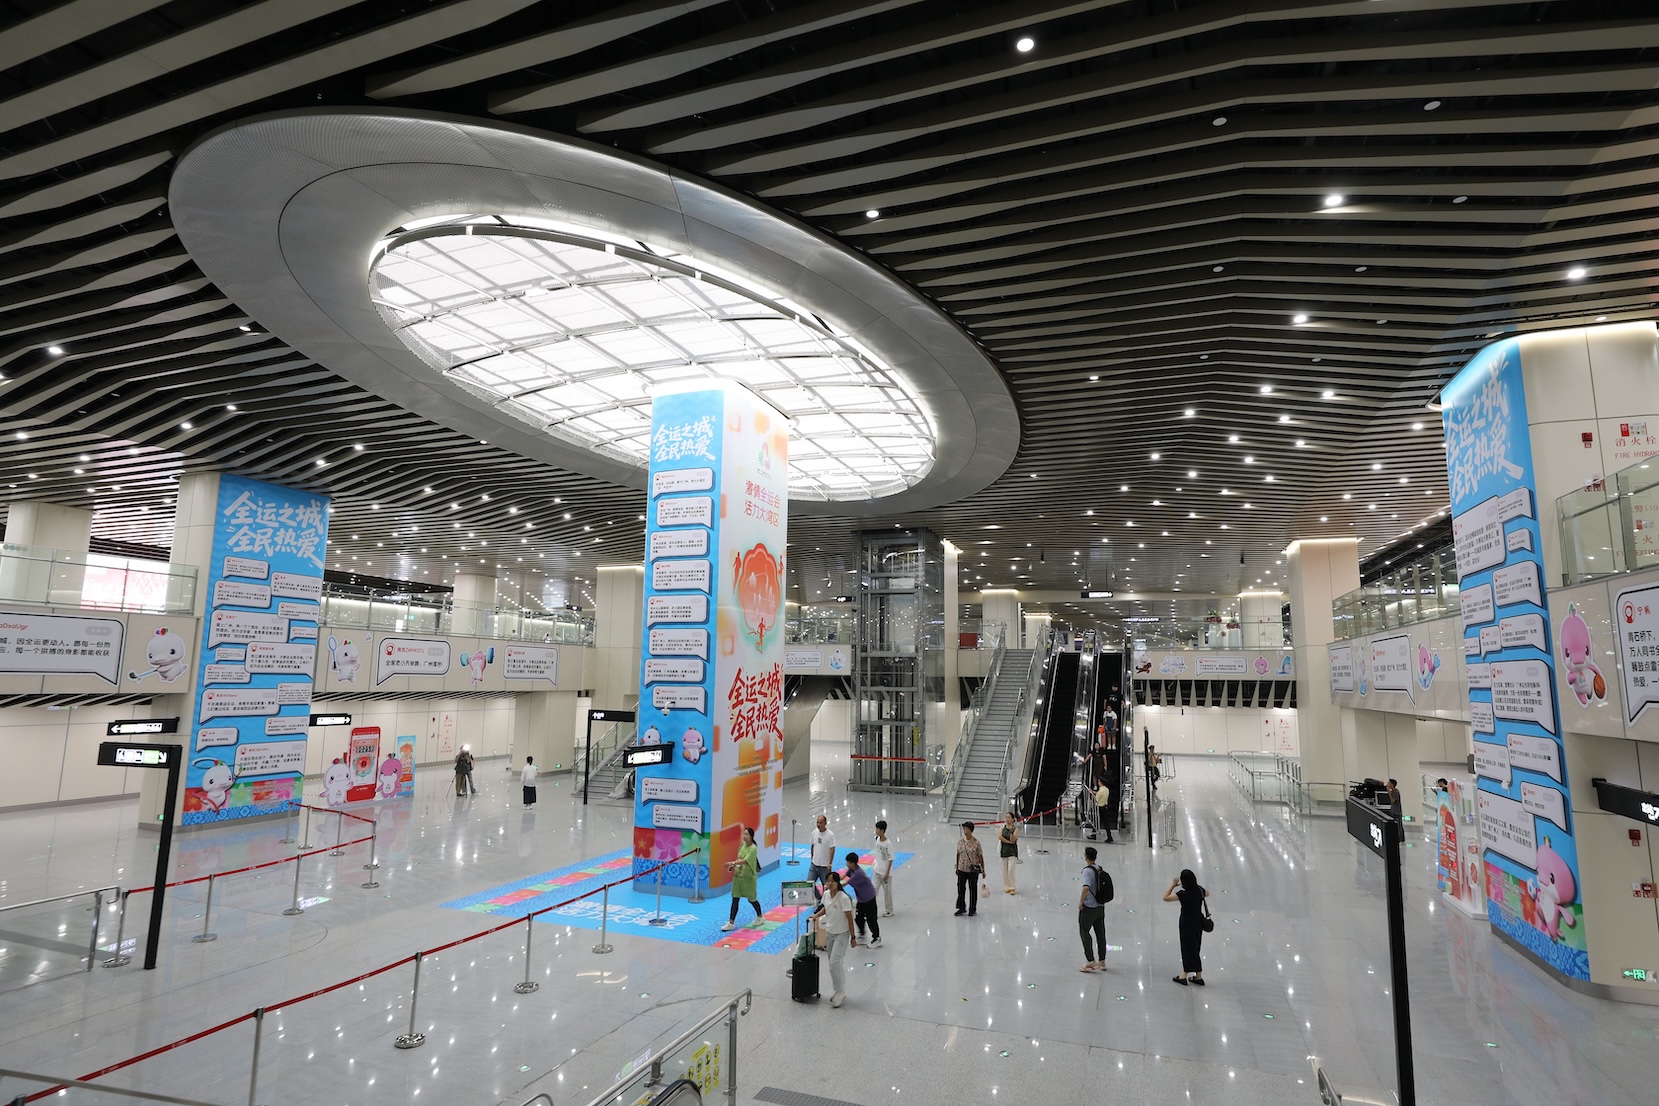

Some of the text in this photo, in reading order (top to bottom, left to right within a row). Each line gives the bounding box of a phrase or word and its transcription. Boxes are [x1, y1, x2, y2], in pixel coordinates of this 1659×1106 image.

[653, 415, 713, 447] 全运之城
[1446, 360, 1510, 466] 全运之城
[655, 434, 717, 462] 全民热爱
[1451, 411, 1525, 505] 全民热爱
[1615, 435, 1657, 447] 消火栓
[224, 490, 324, 535] 全运之城
[744, 500, 780, 527] 活力大湾区
[745, 479, 781, 509] 激情全运会
[226, 525, 325, 570] 全民热爱
[728, 662, 782, 710] 全运之城
[730, 697, 783, 743] 全民热爱
